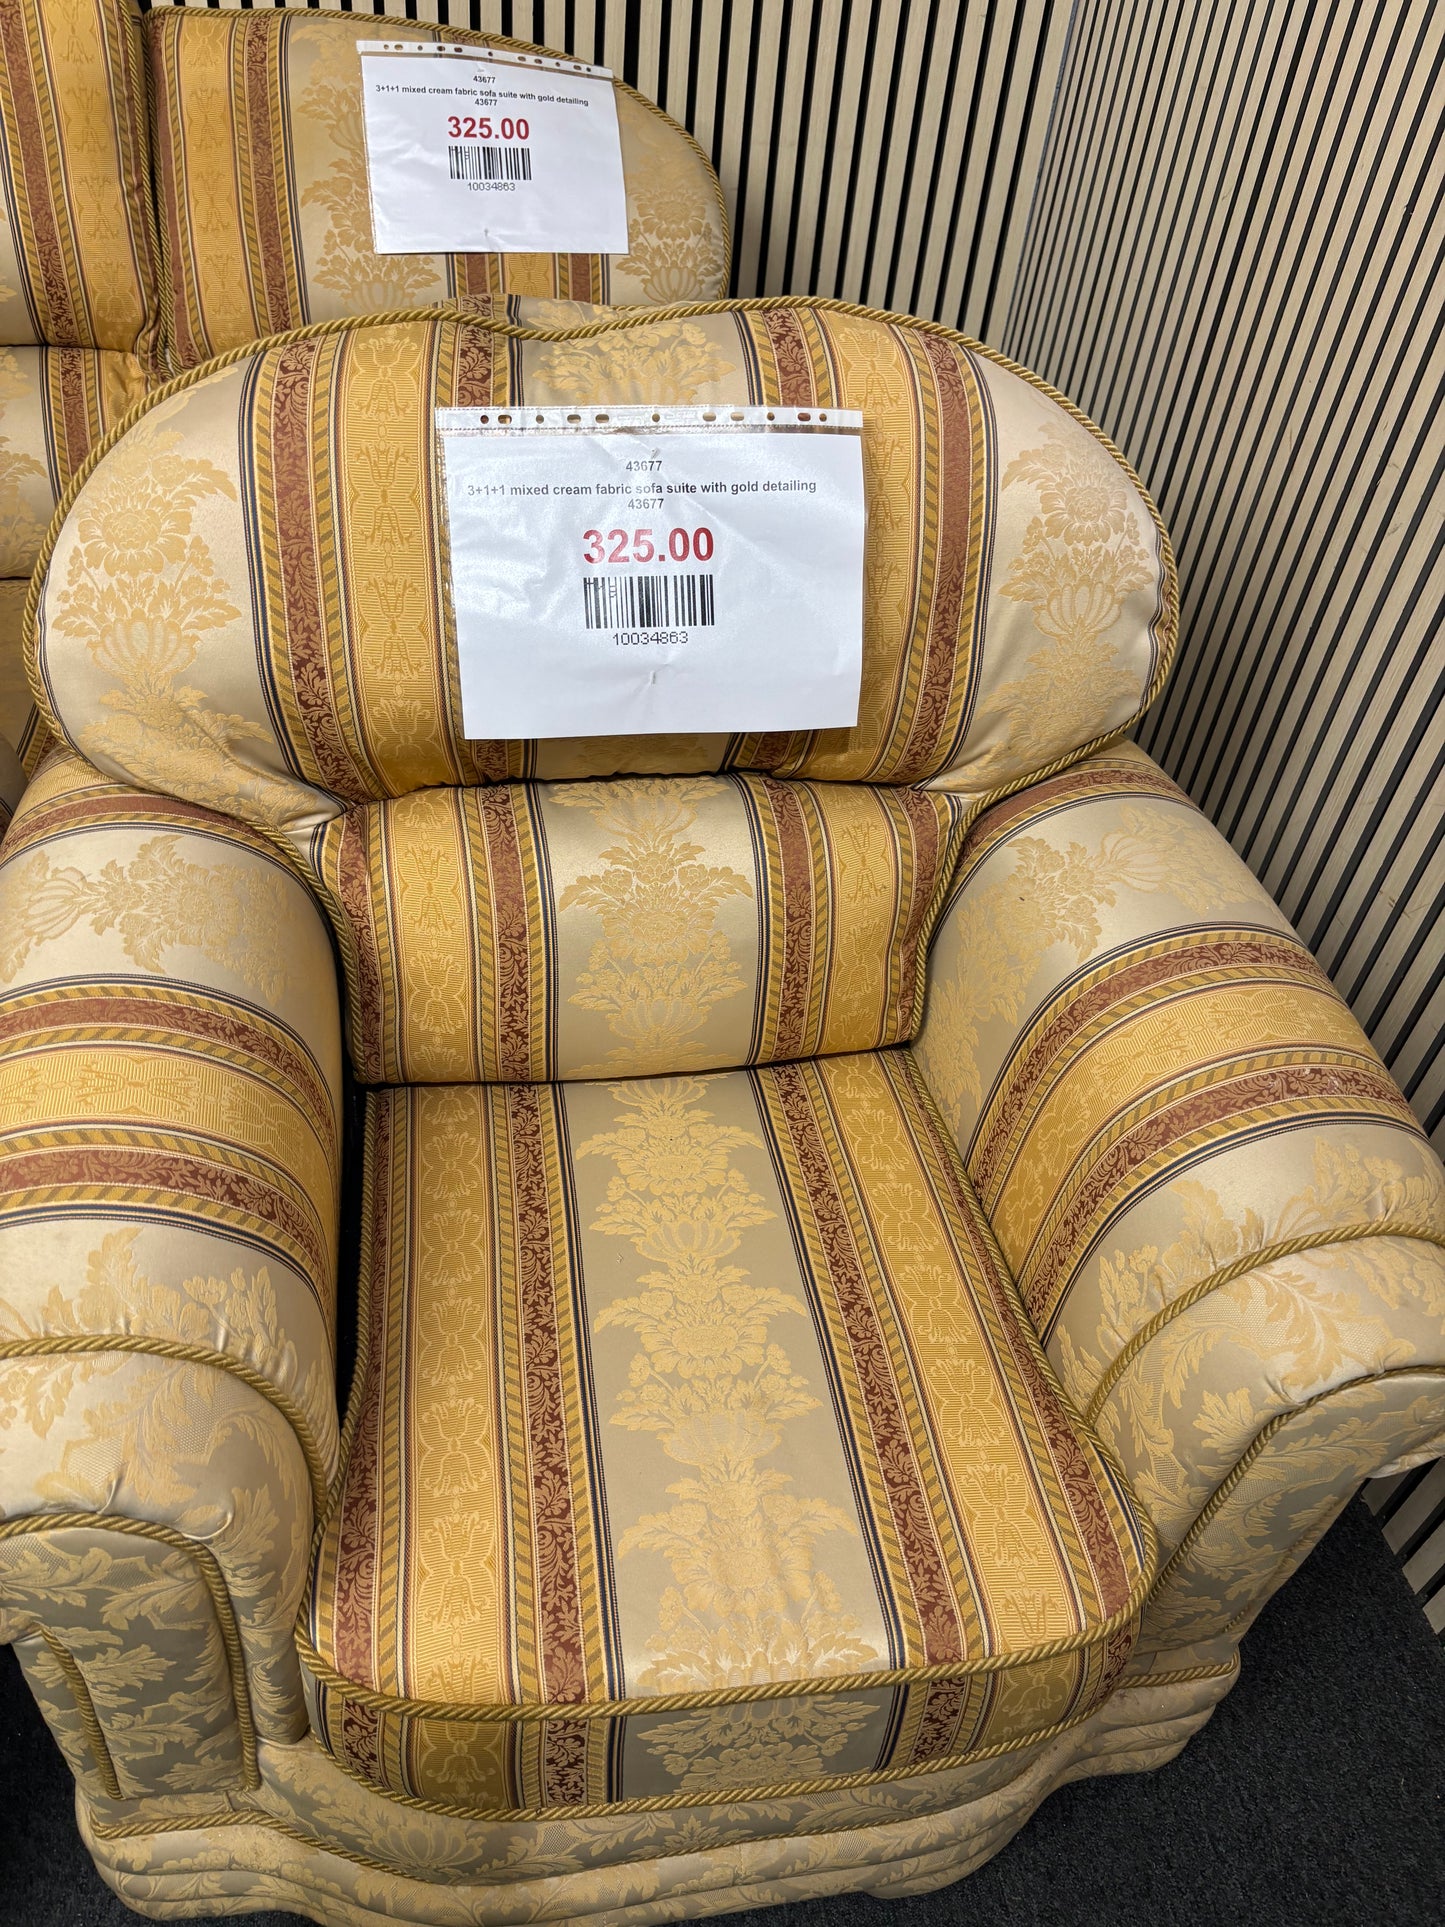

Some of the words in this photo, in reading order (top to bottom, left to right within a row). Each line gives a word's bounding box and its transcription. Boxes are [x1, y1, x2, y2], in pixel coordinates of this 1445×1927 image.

[375, 84, 399, 93] 3+1+1
[402, 85, 426, 94] mixed
[428, 87, 453, 95] cream
[454, 87, 478, 96] fabric
[480, 89, 497, 97] sofa
[498, 90, 518, 99] suite
[519, 92, 536, 100] with
[537, 94, 555, 103] gold
[556, 96, 589, 107] detailing
[474, 98, 498, 106] 43677
[447, 116, 530, 140] 325.00
[467, 182, 516, 191] 10034863
[625, 460, 663, 472] 43677
[467, 484, 506, 496] 3+1+1
[510, 484, 549, 495] mixed
[553, 486, 592, 495] cream
[596, 483, 632, 495] fabric
[635, 483, 663, 494] sofa
[666, 482, 697, 494] suite
[700, 481, 727, 493] with
[731, 481, 759, 495] gold
[762, 480, 817, 493] detailing
[627, 498, 664, 510] 43677
[582, 527, 714, 564] 325.00
[612, 631, 689, 646] 10034863
